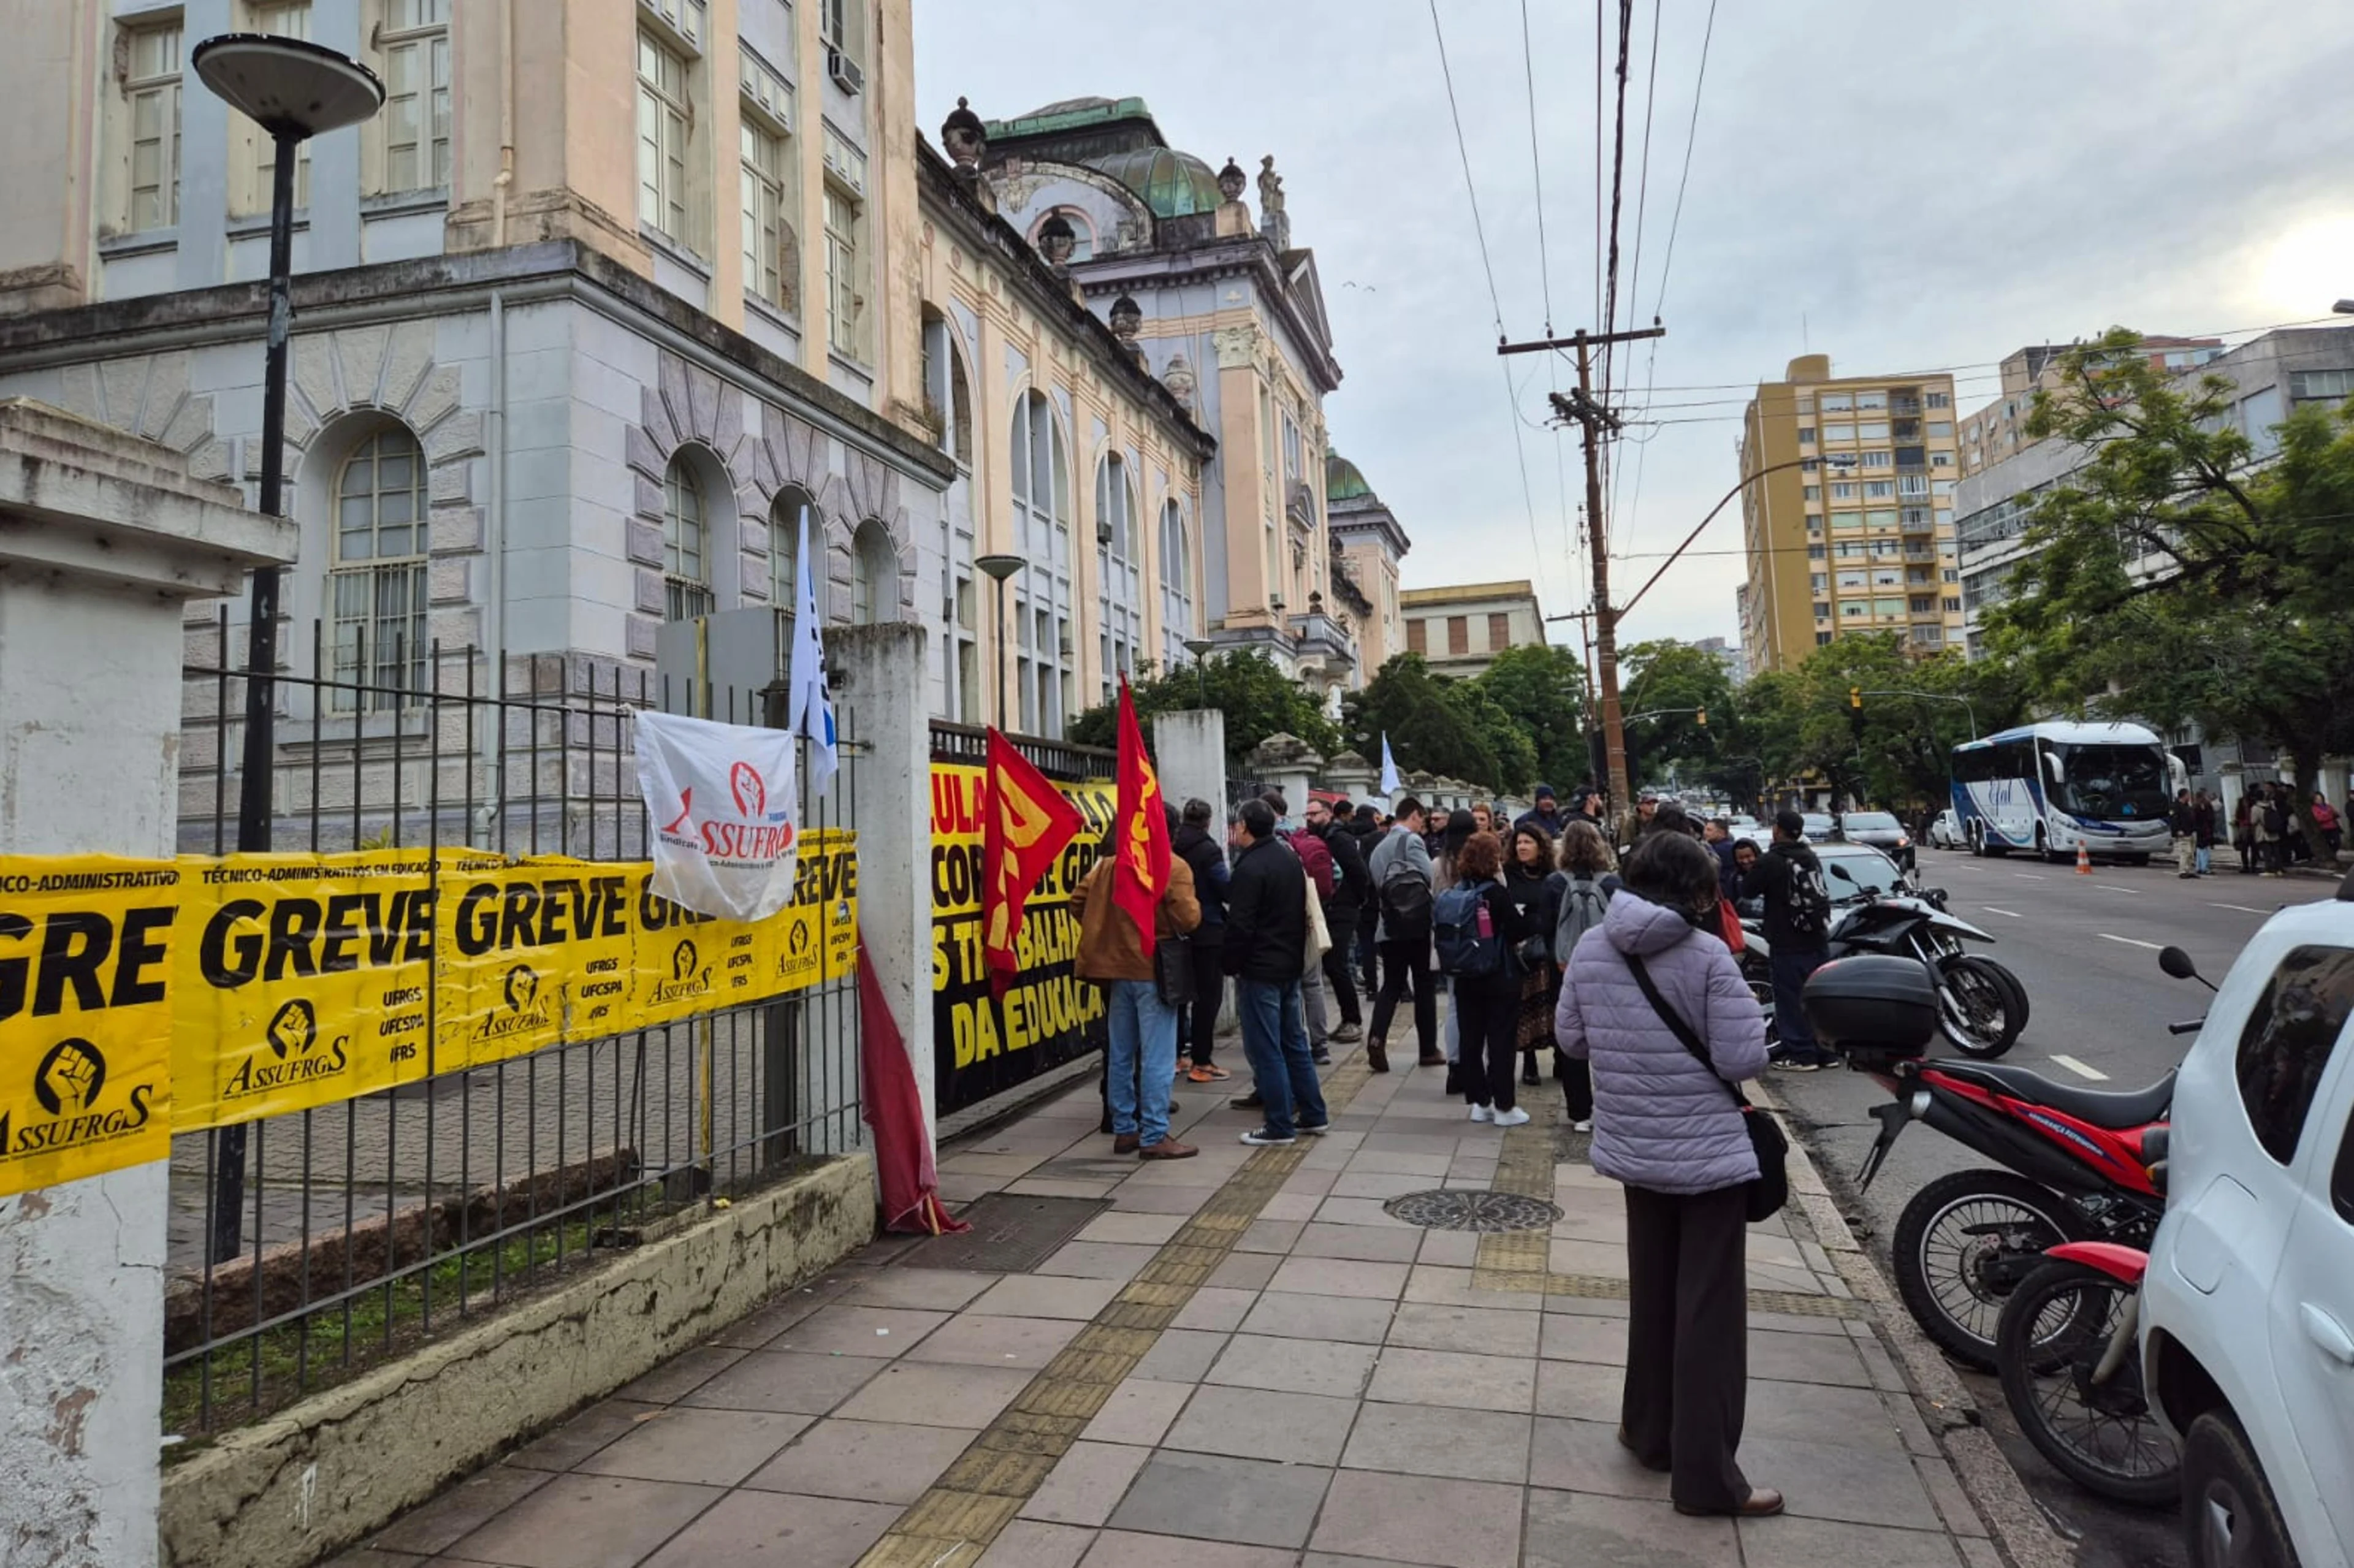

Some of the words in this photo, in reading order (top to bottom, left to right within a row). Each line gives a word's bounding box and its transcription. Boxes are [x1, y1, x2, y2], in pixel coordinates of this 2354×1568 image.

[931, 773, 985, 834] ULA
[200, 888, 440, 989] GREVE
[455, 875, 626, 956] GREVE
[581, 980, 622, 999] UFCSPA
[586, 957, 619, 974] UFRGS
[383, 986, 423, 1007] UFRGS
[390, 1042, 416, 1063] IFRS
[951, 996, 1000, 1069] DA
[224, 1035, 349, 1095] ASSUFRGS
